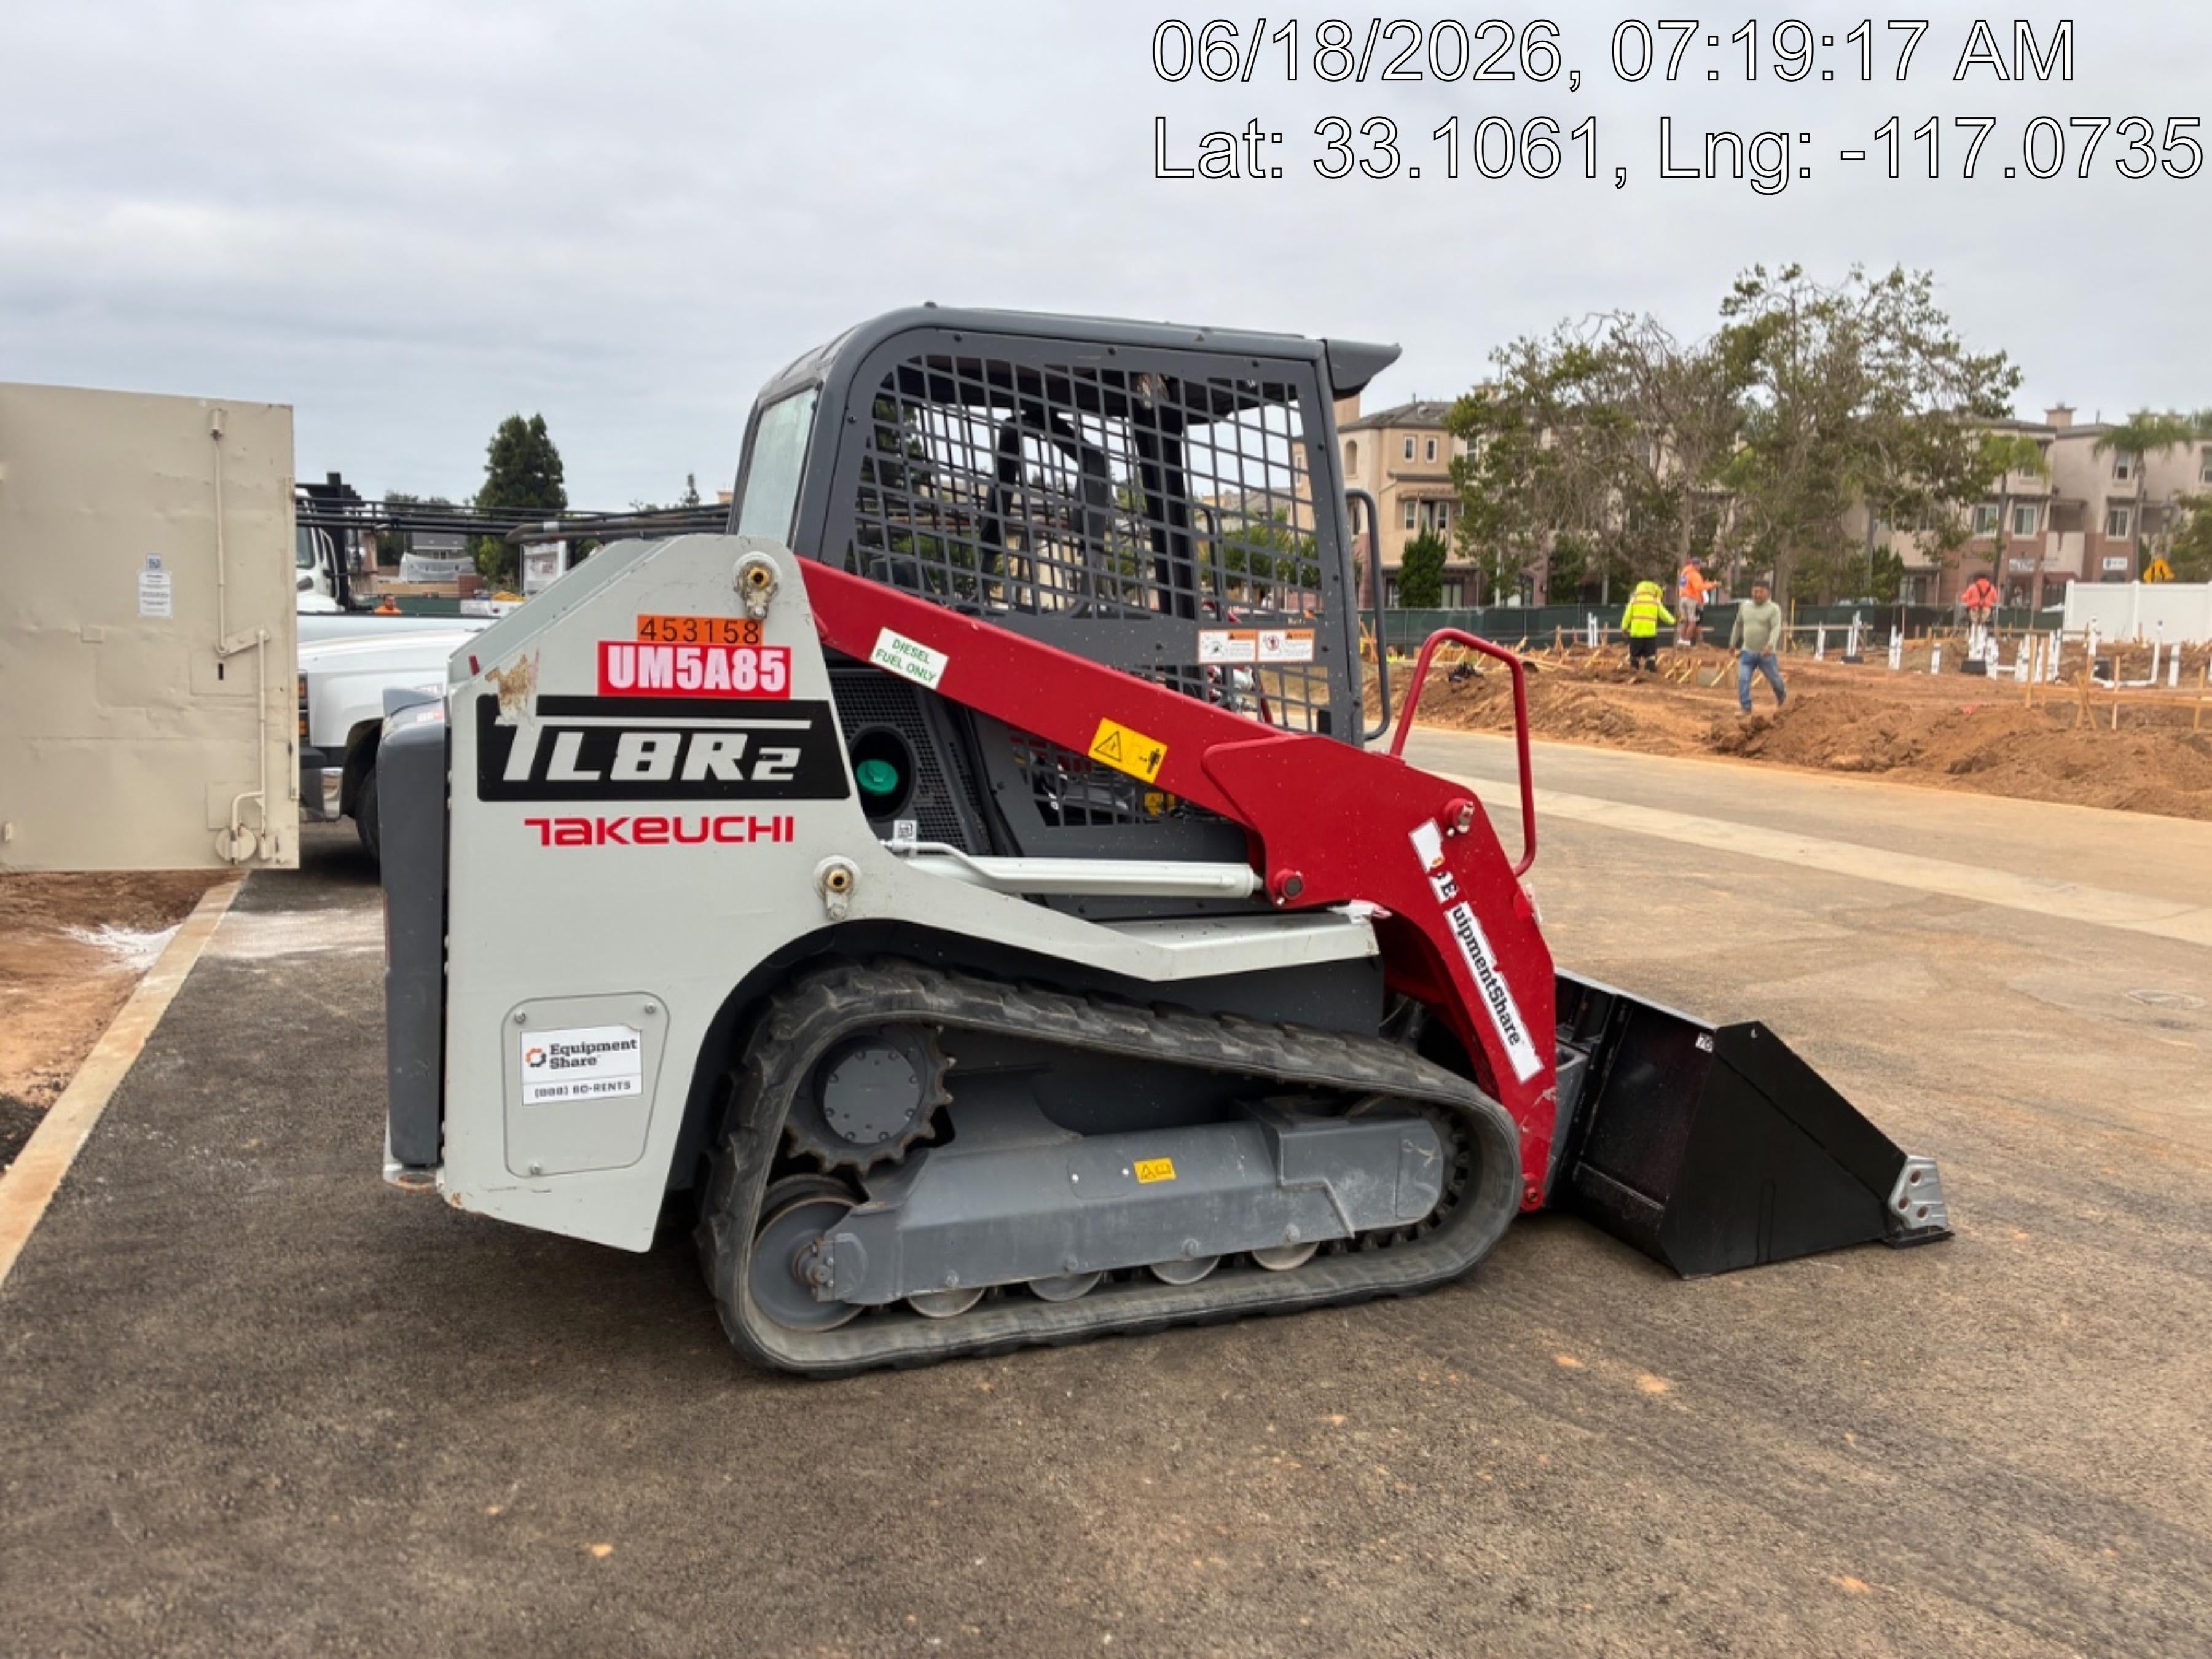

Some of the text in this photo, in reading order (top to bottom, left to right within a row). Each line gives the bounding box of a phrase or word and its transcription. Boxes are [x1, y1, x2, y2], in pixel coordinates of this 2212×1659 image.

[640, 617, 760, 645] 453158
[892, 638, 930, 664] DIESEL
[607, 645, 786, 692] UM5A85
[875, 648, 938, 683] FUEL ONLY
[549, 1039, 637, 1056] Equipment
[549, 1057, 597, 1069] Share
